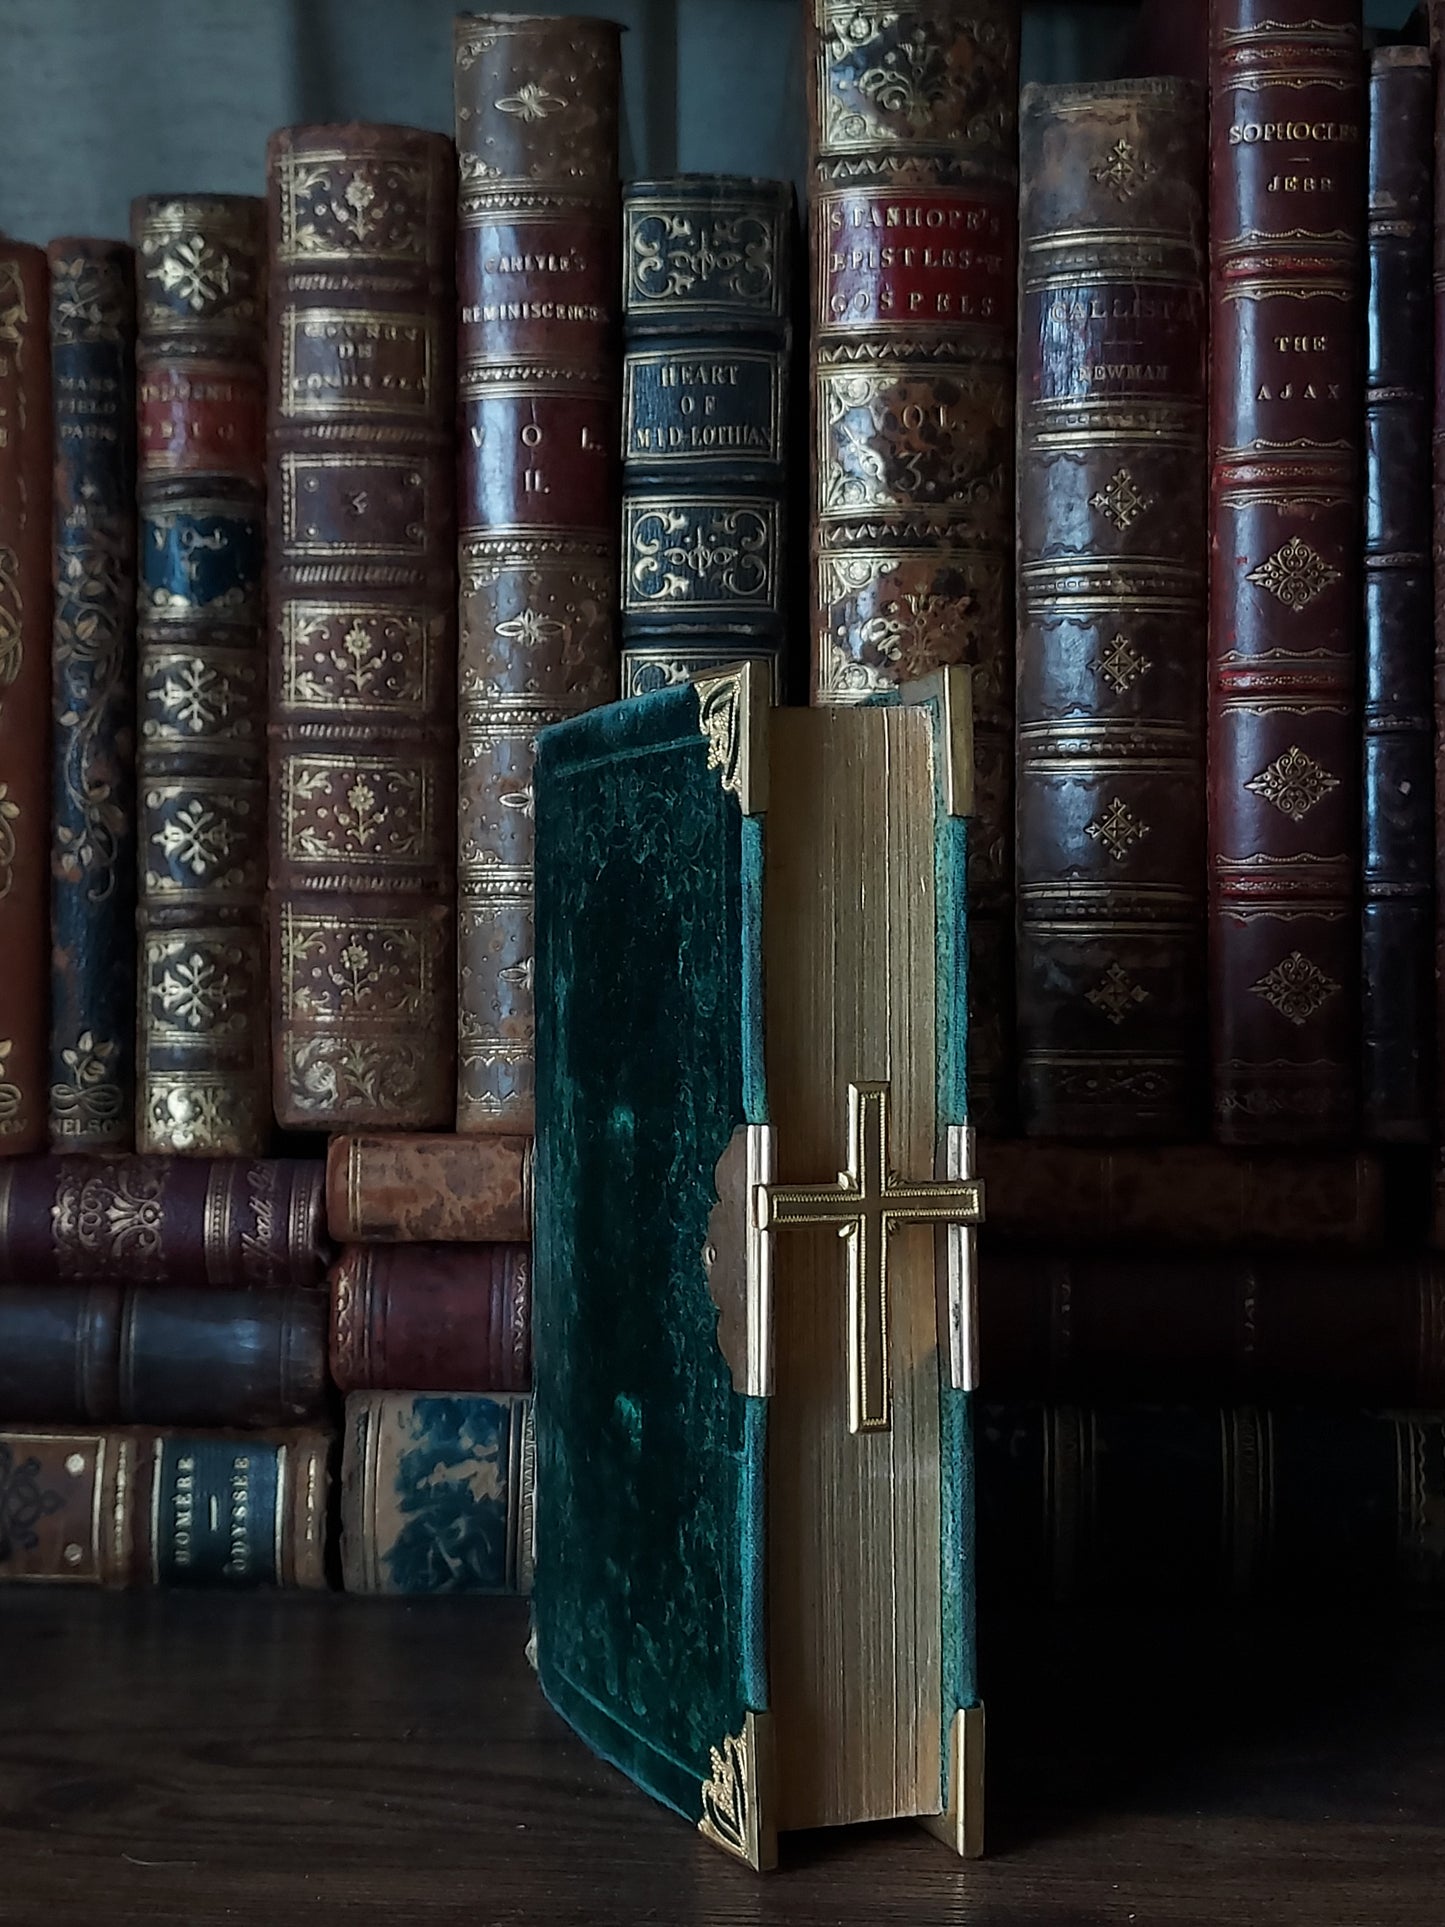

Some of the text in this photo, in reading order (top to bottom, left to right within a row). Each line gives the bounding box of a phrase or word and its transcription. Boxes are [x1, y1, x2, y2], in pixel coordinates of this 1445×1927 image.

[1228, 121, 1359, 145] SOPHOCLES
[485, 247, 587, 273] CARLYLE'S
[831, 287, 993, 316] GOSPELS
[1274, 335, 1327, 352] THE
[661, 365, 739, 387] HEART
[1257, 383, 1340, 400] AJAX
[681, 395, 717, 416] OF
[48, 1118, 125, 1136] NELSO
